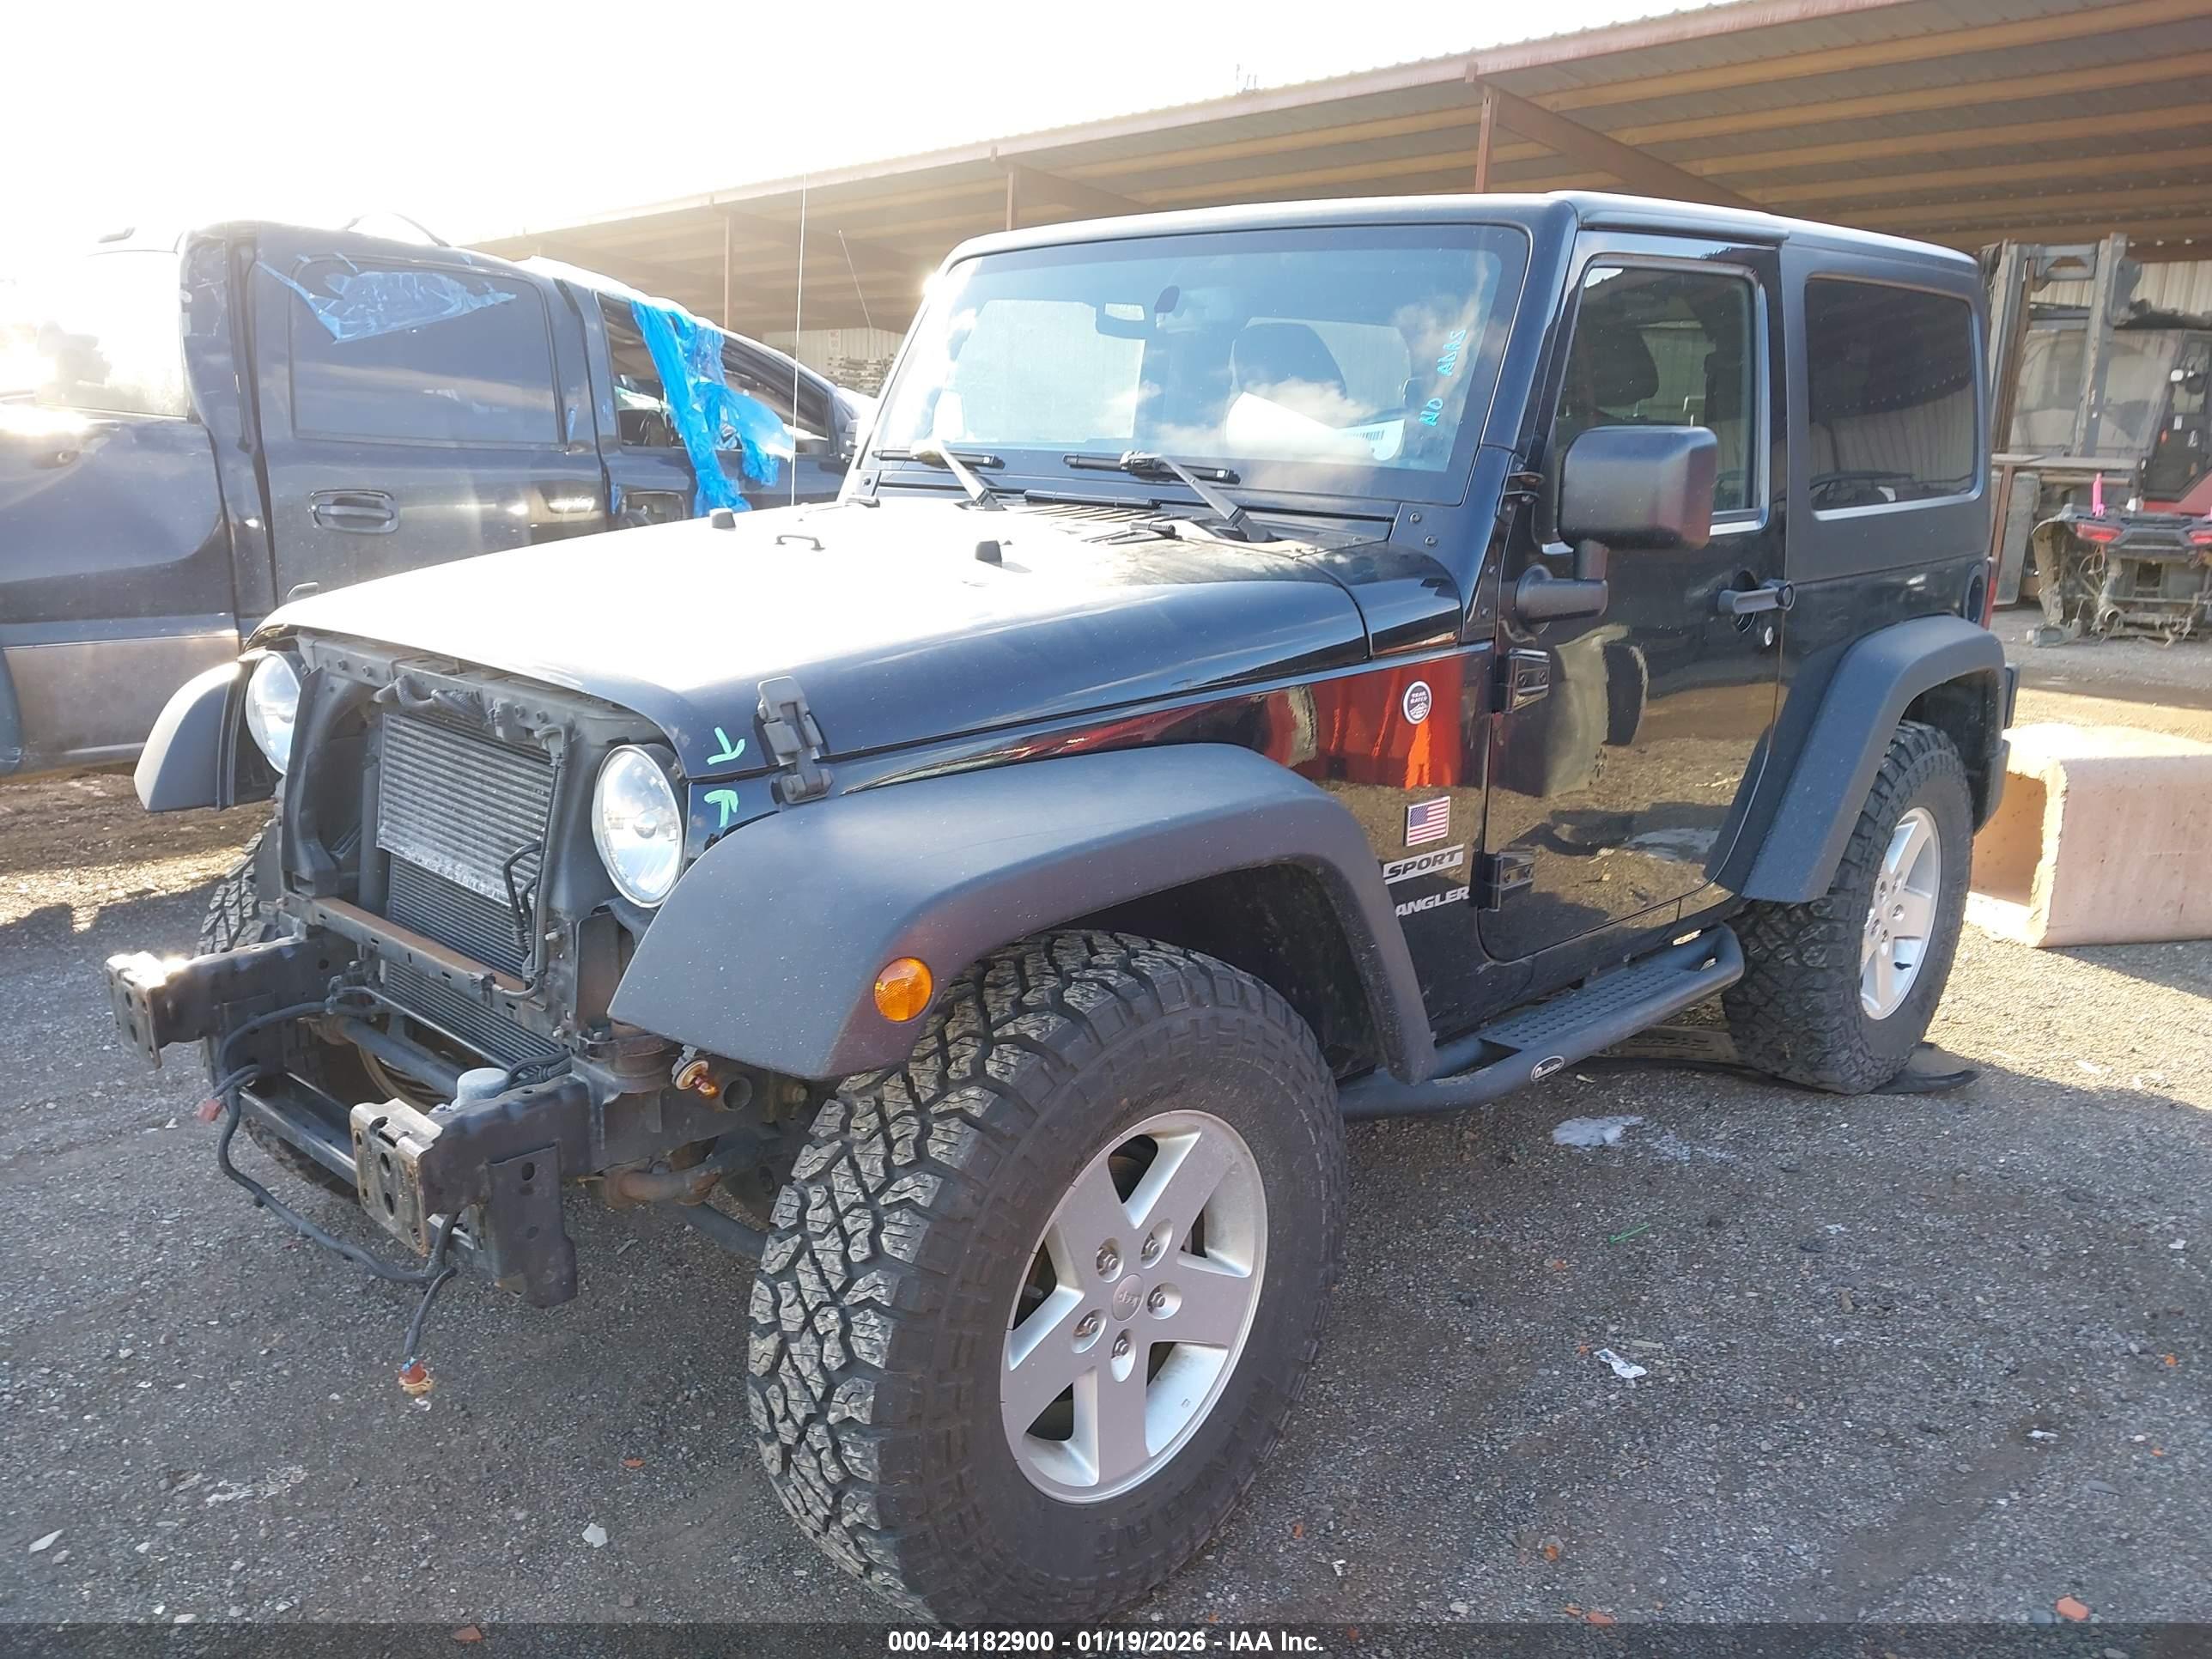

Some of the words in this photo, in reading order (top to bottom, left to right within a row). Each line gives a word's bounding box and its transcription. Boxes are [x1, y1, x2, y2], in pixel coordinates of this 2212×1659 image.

[1419, 398, 1443, 426] NO
[1384, 848, 1462, 878] SPORT
[1395, 885, 1470, 917] ANGLER
